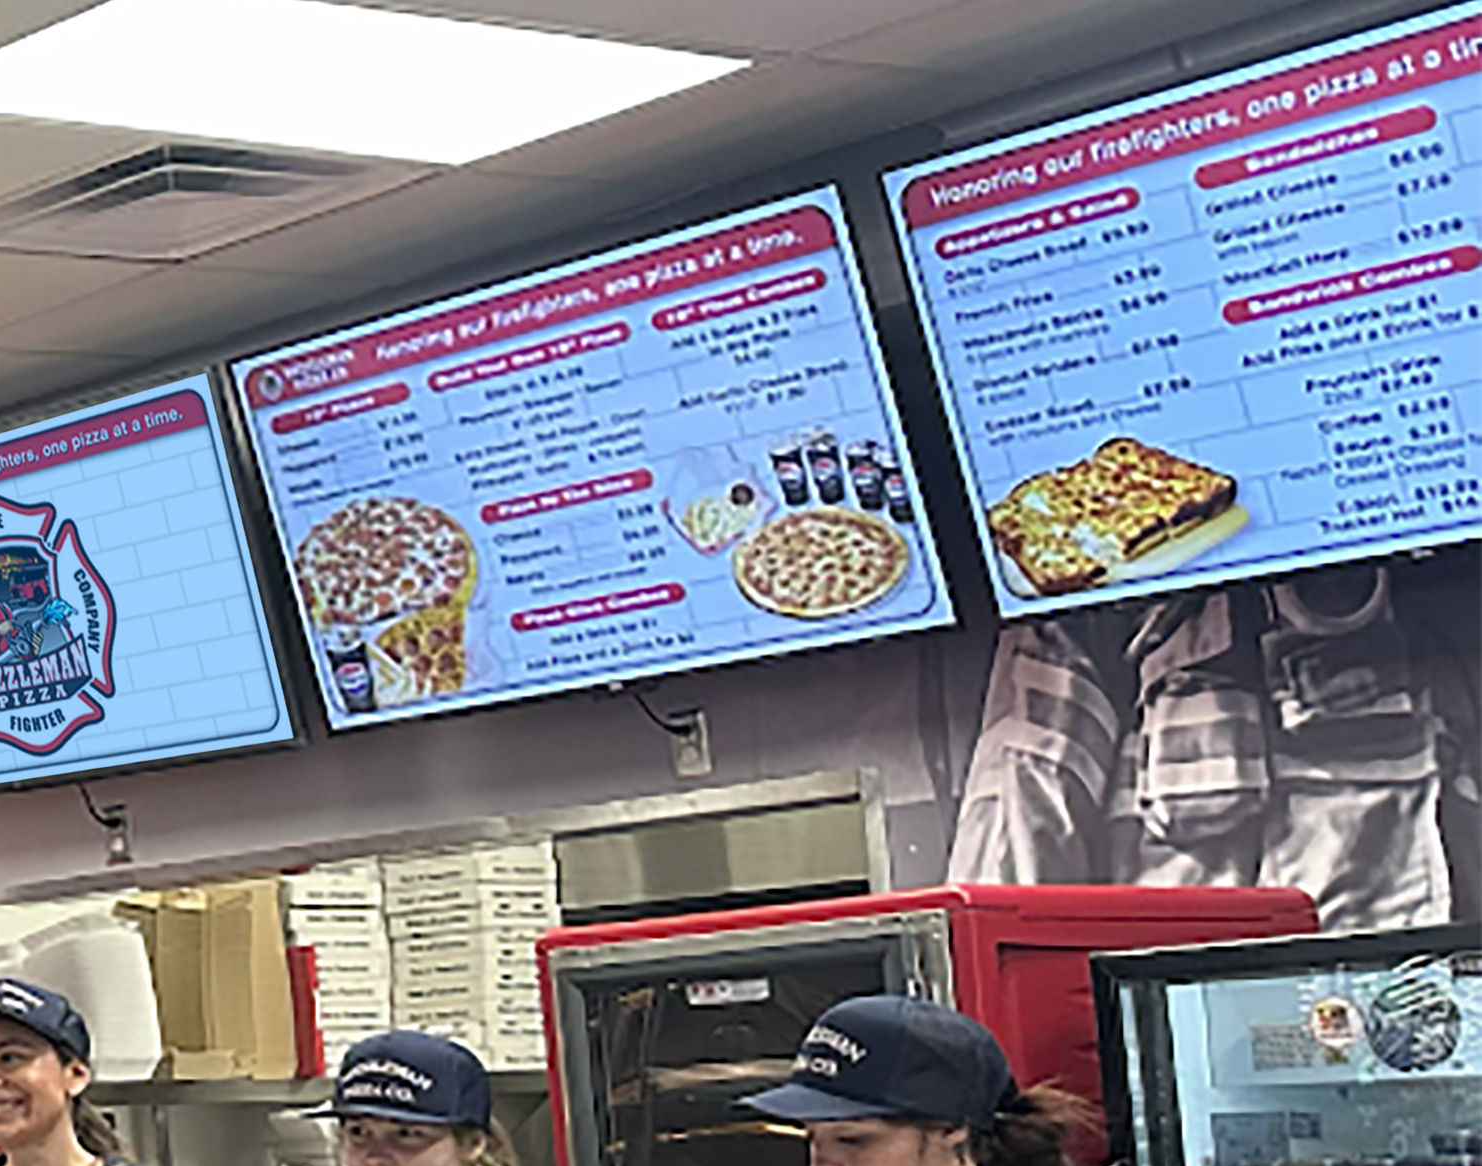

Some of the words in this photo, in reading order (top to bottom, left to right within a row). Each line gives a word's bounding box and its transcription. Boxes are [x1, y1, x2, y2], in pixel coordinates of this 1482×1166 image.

[930, 158, 1038, 209] Honoring
[1041, 146, 1085, 176] our
[1245, 88, 1297, 119] one
[1302, 63, 1379, 106] pizza
[1385, 53, 1415, 80] at
[1422, 48, 1442, 70] a
[42, 440, 68, 459] one
[72, 426, 110, 453] pizza
[113, 421, 129, 438] at
[131, 418, 141, 433] a
[144, 406, 184, 429] time.
[73, 568, 100, 653] COMPANY
[10, 708, 66, 732] FIGHTER
